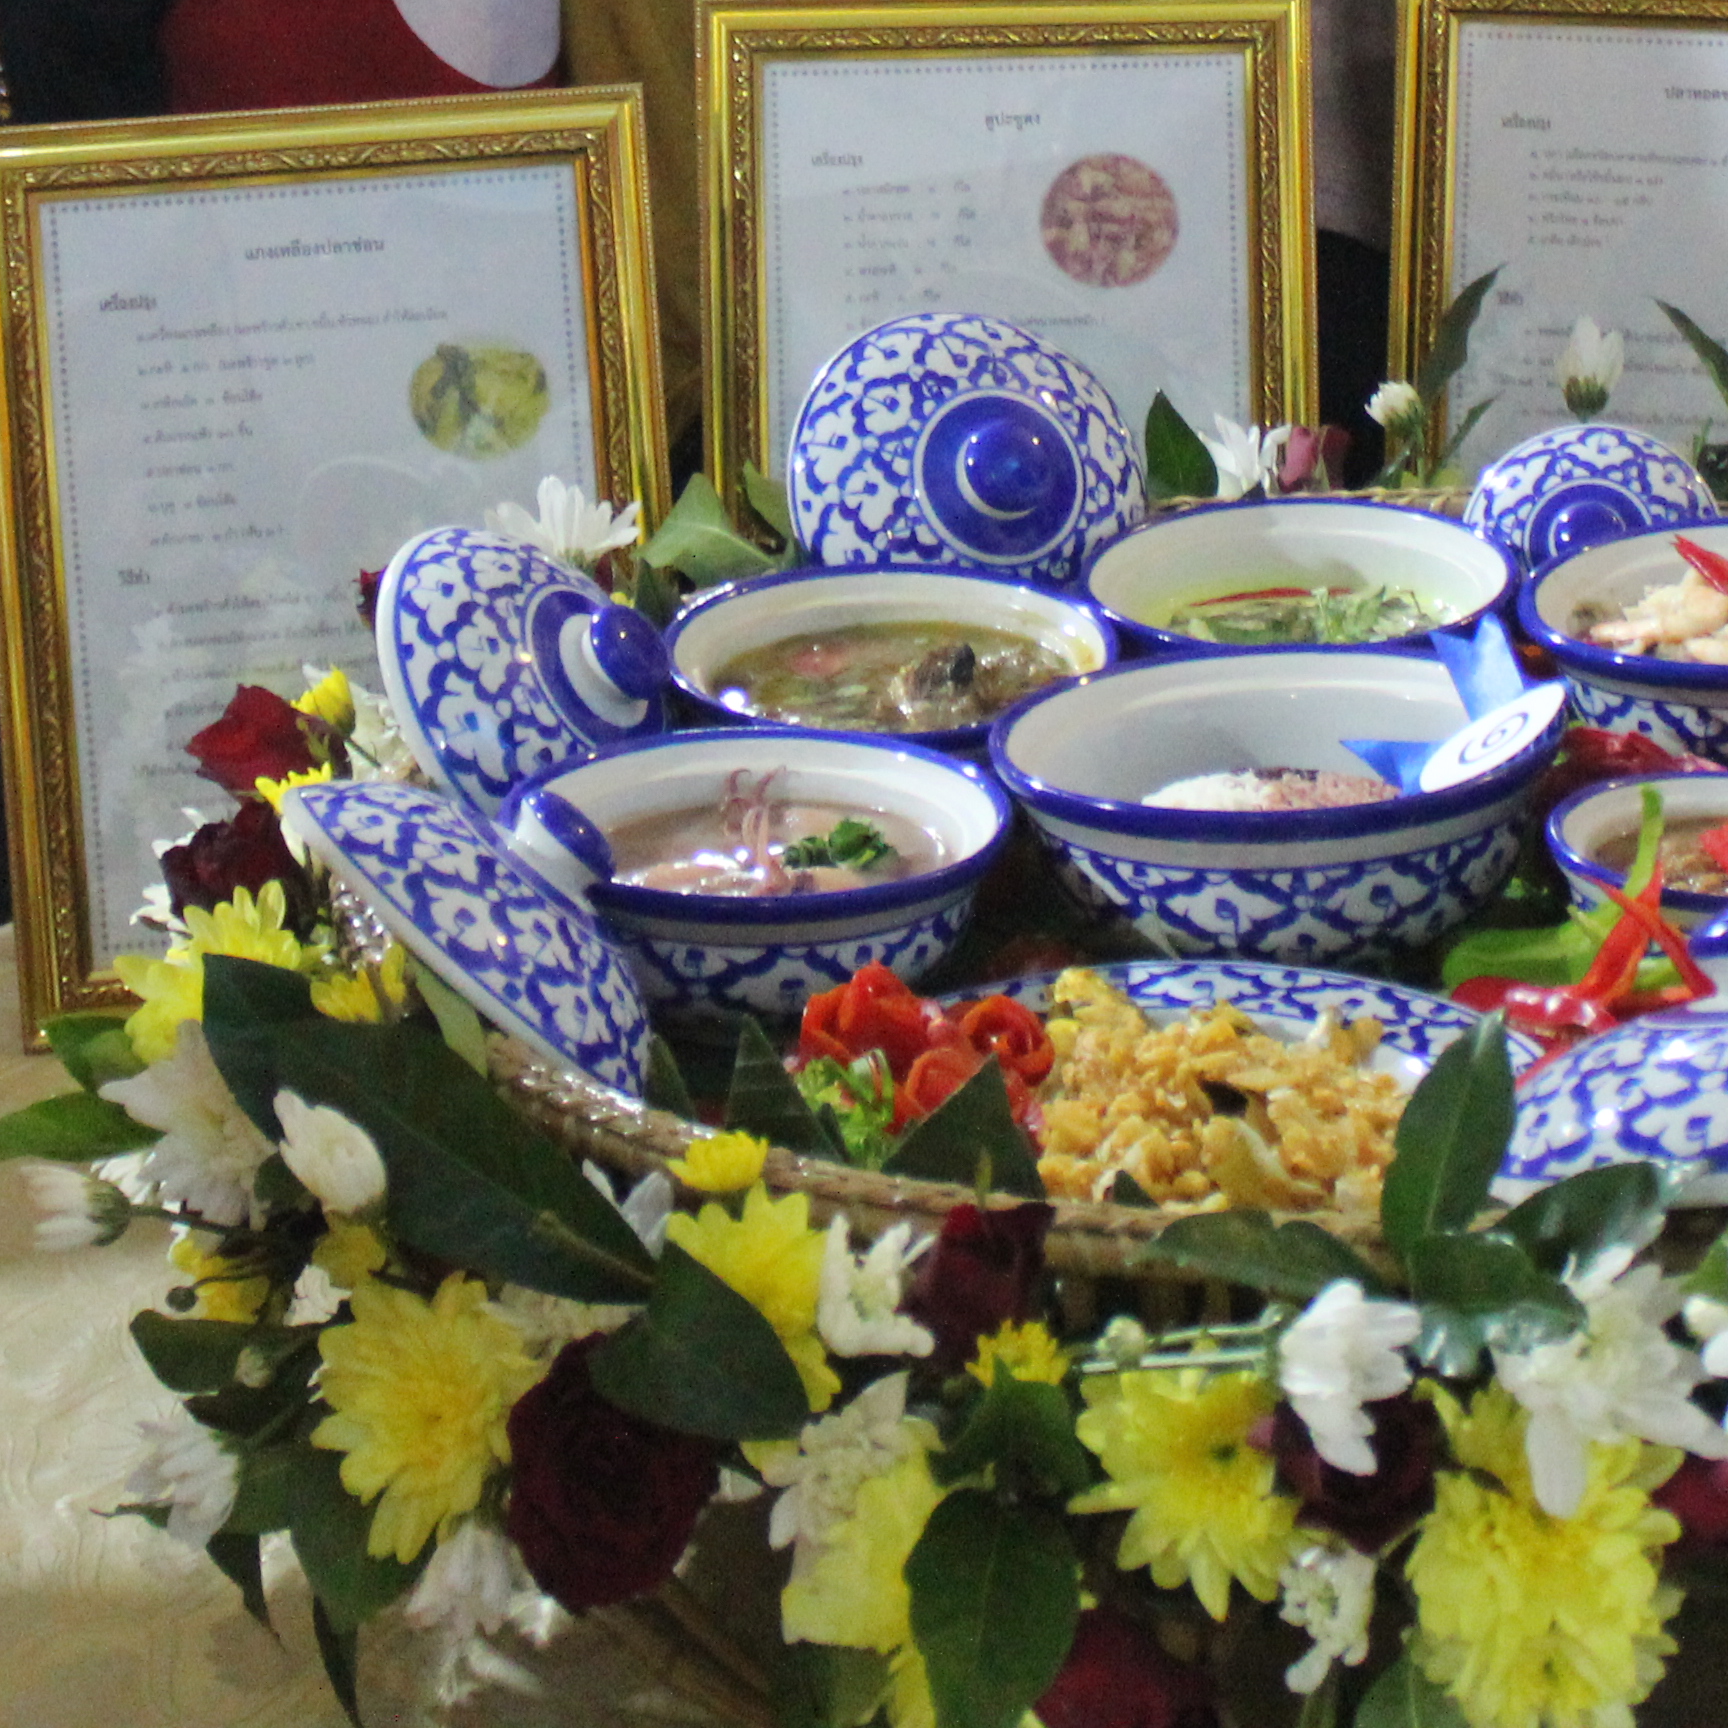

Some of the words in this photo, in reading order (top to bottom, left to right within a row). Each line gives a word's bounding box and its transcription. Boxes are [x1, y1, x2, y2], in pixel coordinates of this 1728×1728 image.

[244, 235, 385, 261] แกงเหลืองปลาช่อน
